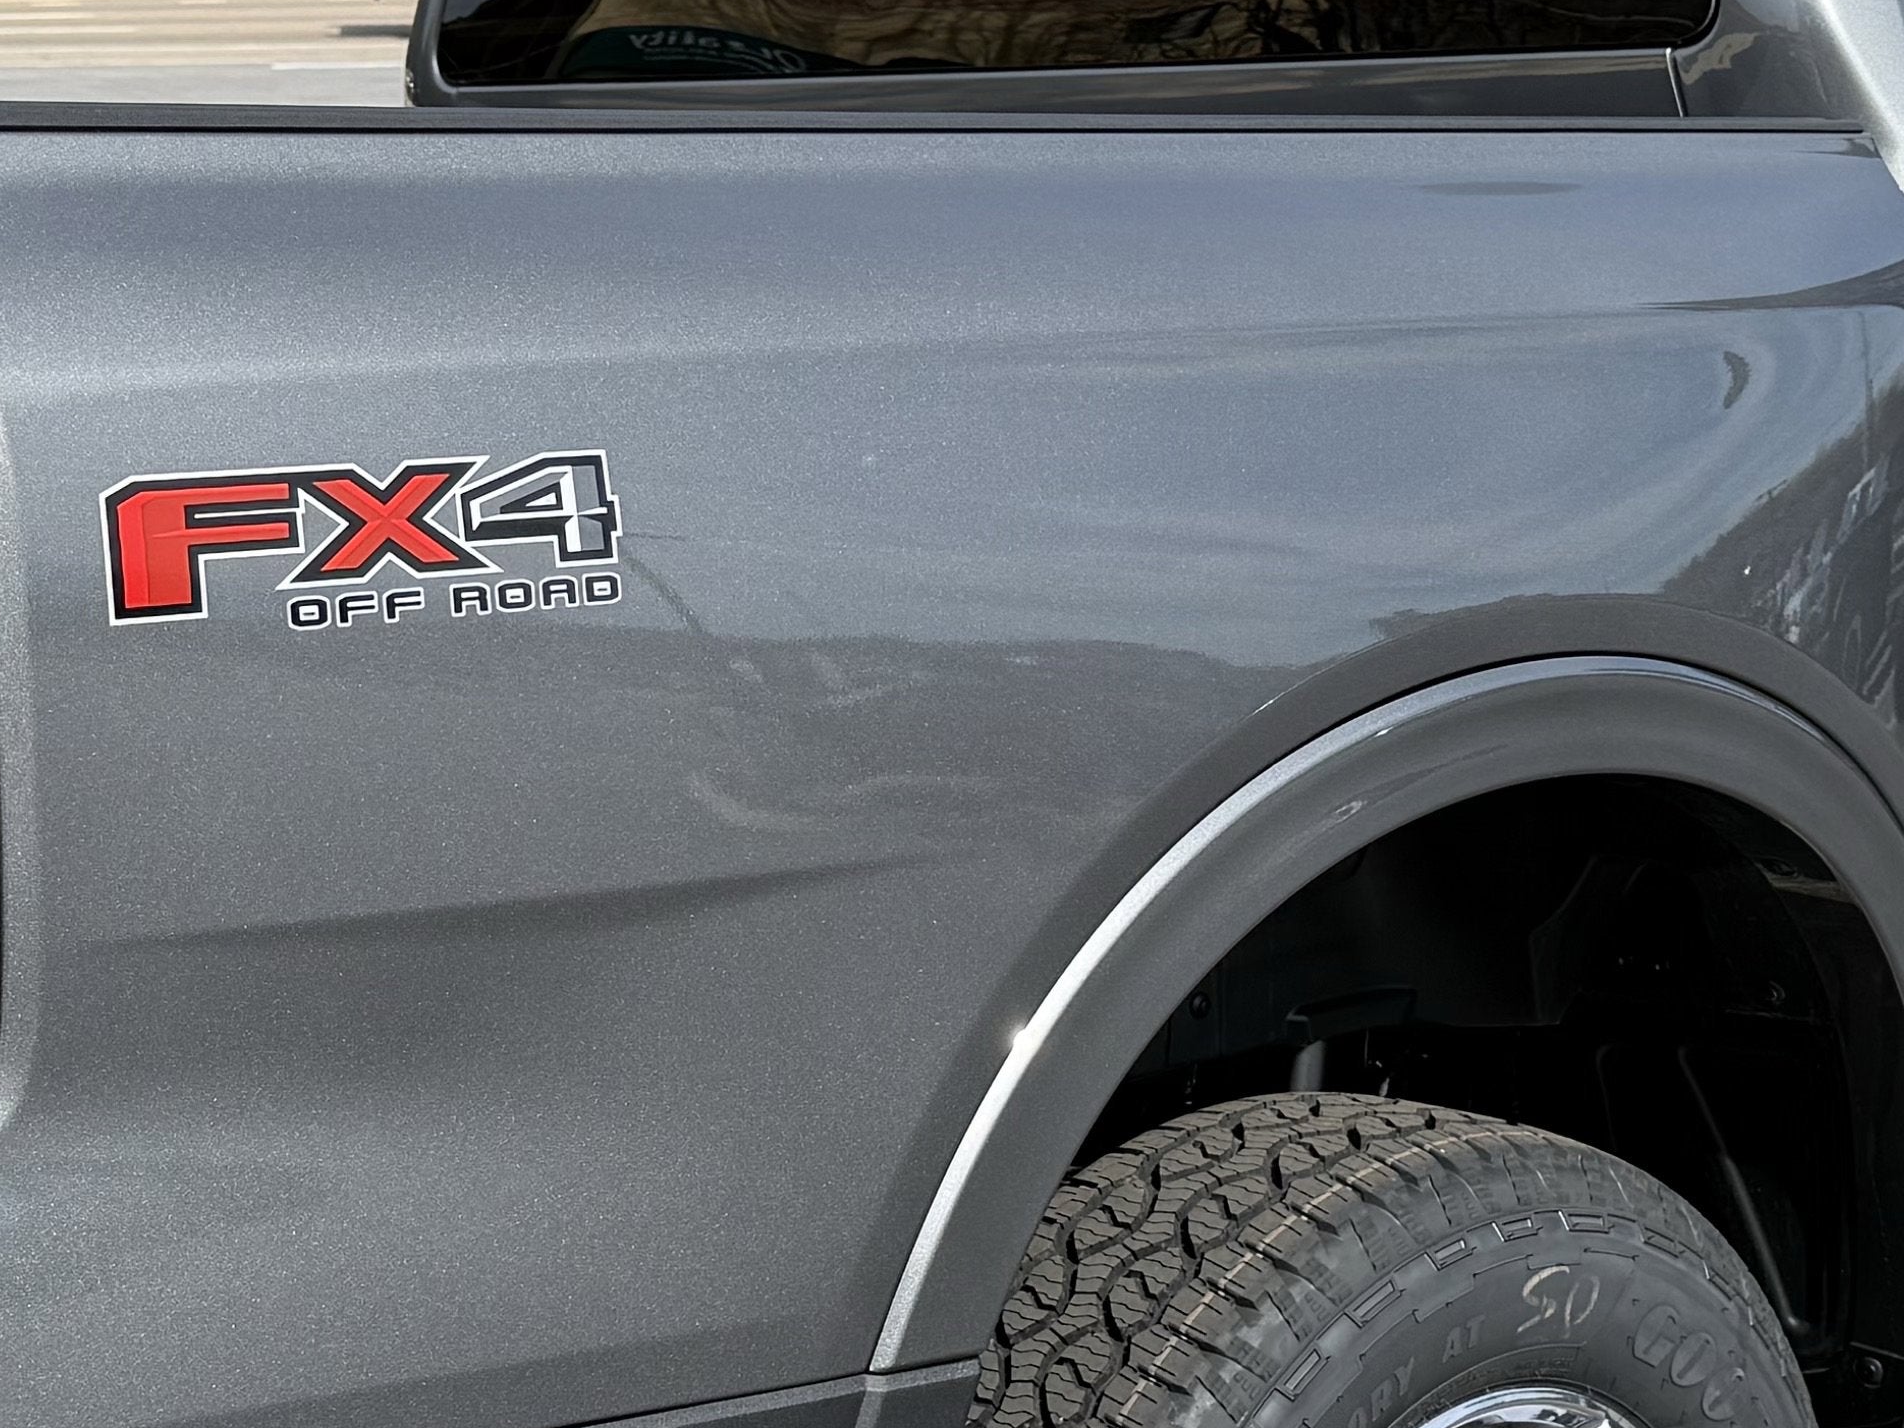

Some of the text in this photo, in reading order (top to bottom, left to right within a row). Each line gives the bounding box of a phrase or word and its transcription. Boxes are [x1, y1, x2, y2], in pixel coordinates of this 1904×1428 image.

[99, 449, 623, 626] FX4
[287, 572, 622, 631] OFF ROAD
[1442, 1314, 1486, 1364] AT
